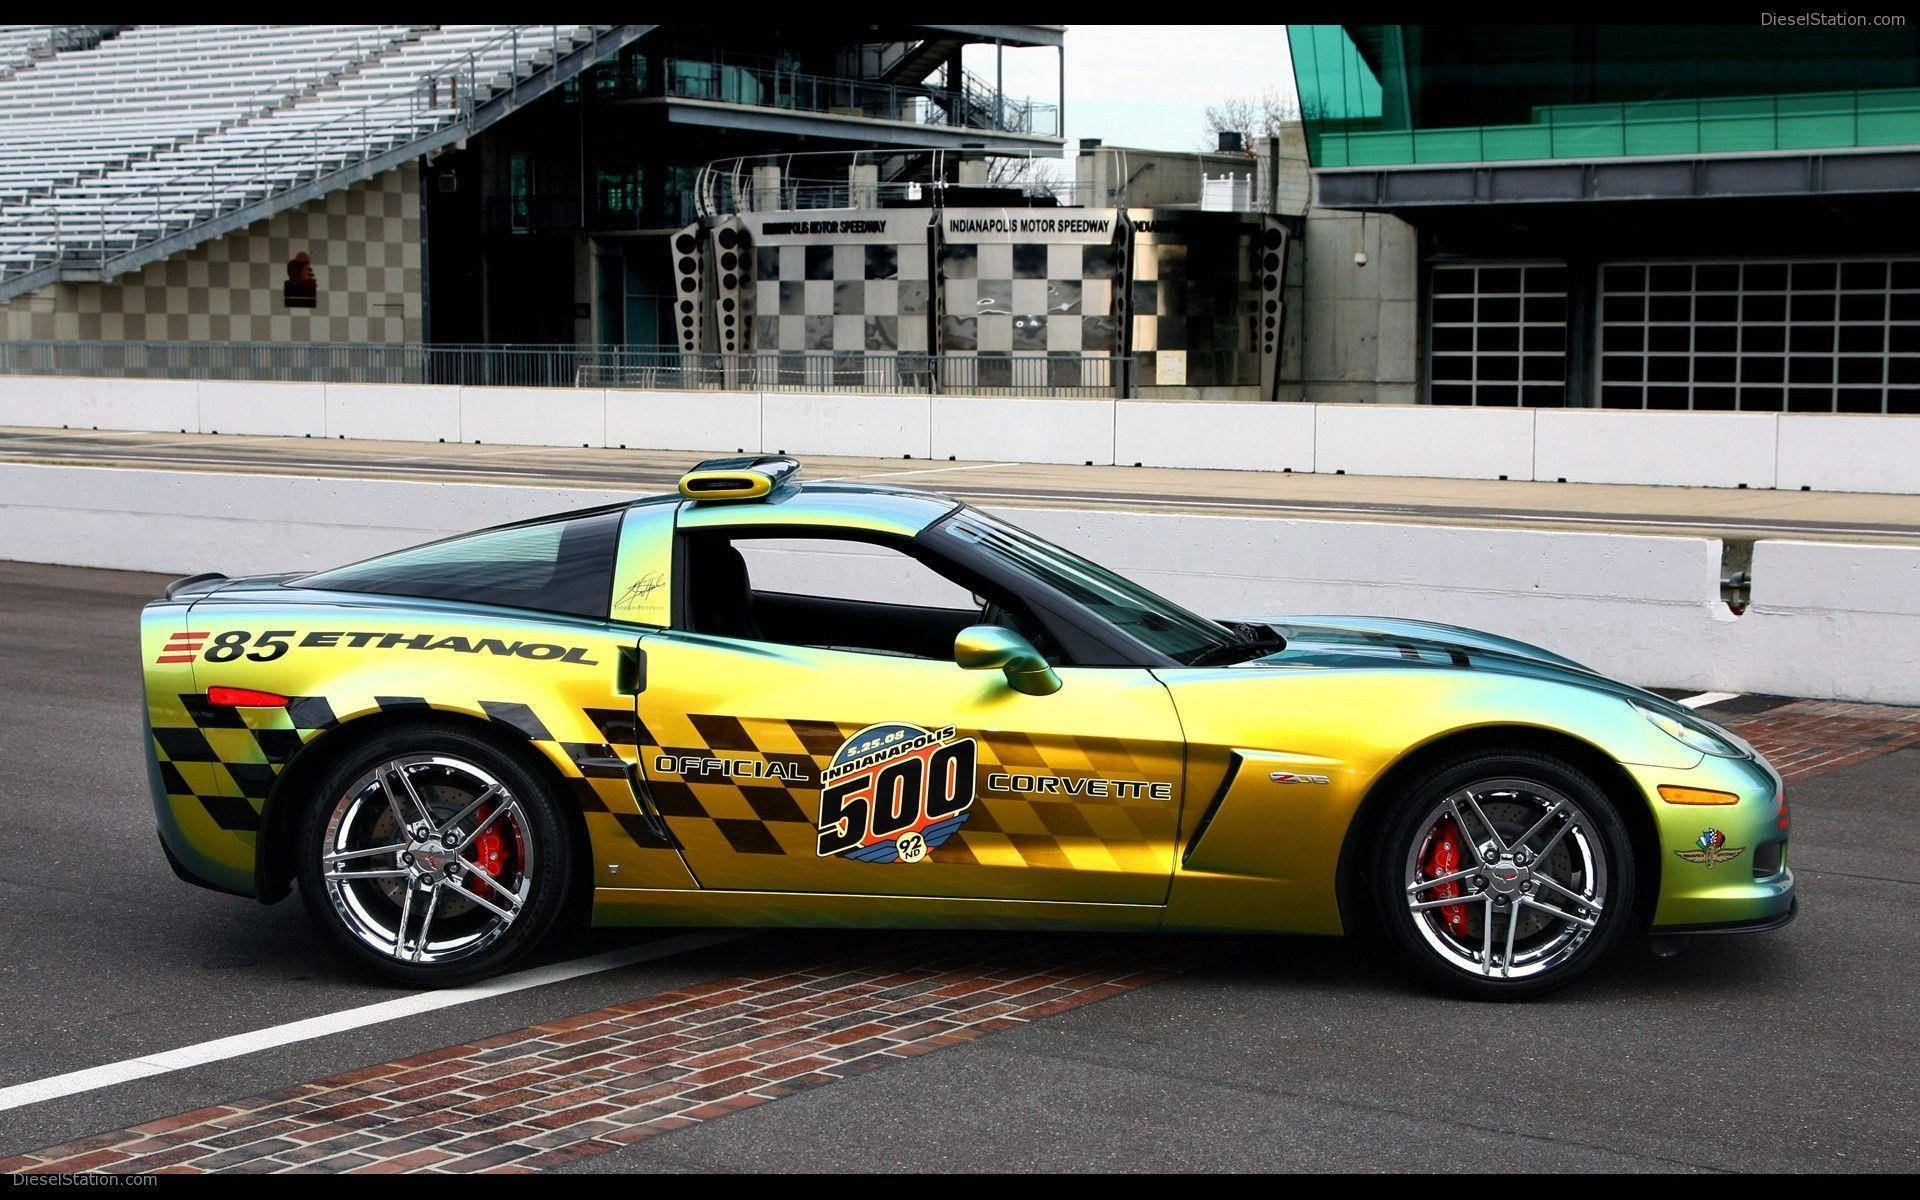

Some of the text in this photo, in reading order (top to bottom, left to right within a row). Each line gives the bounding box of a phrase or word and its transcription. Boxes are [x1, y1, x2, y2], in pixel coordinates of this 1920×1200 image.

[840, 220, 887, 233] SPEEDWAY
[949, 219, 1110, 233] INDIANAPOLIS MOTOR SPEEDWAY
[299, 631, 599, 666] ETHANOL
[821, 725, 956, 784] INDIANAPOLIS
[847, 730, 905, 757] 5.25.08
[655, 755, 809, 782] OFFICIAL
[817, 738, 977, 857] 500
[988, 772, 1172, 800] CORVETTE
[899, 835, 922, 853] 92
[905, 849, 920, 860] ND
